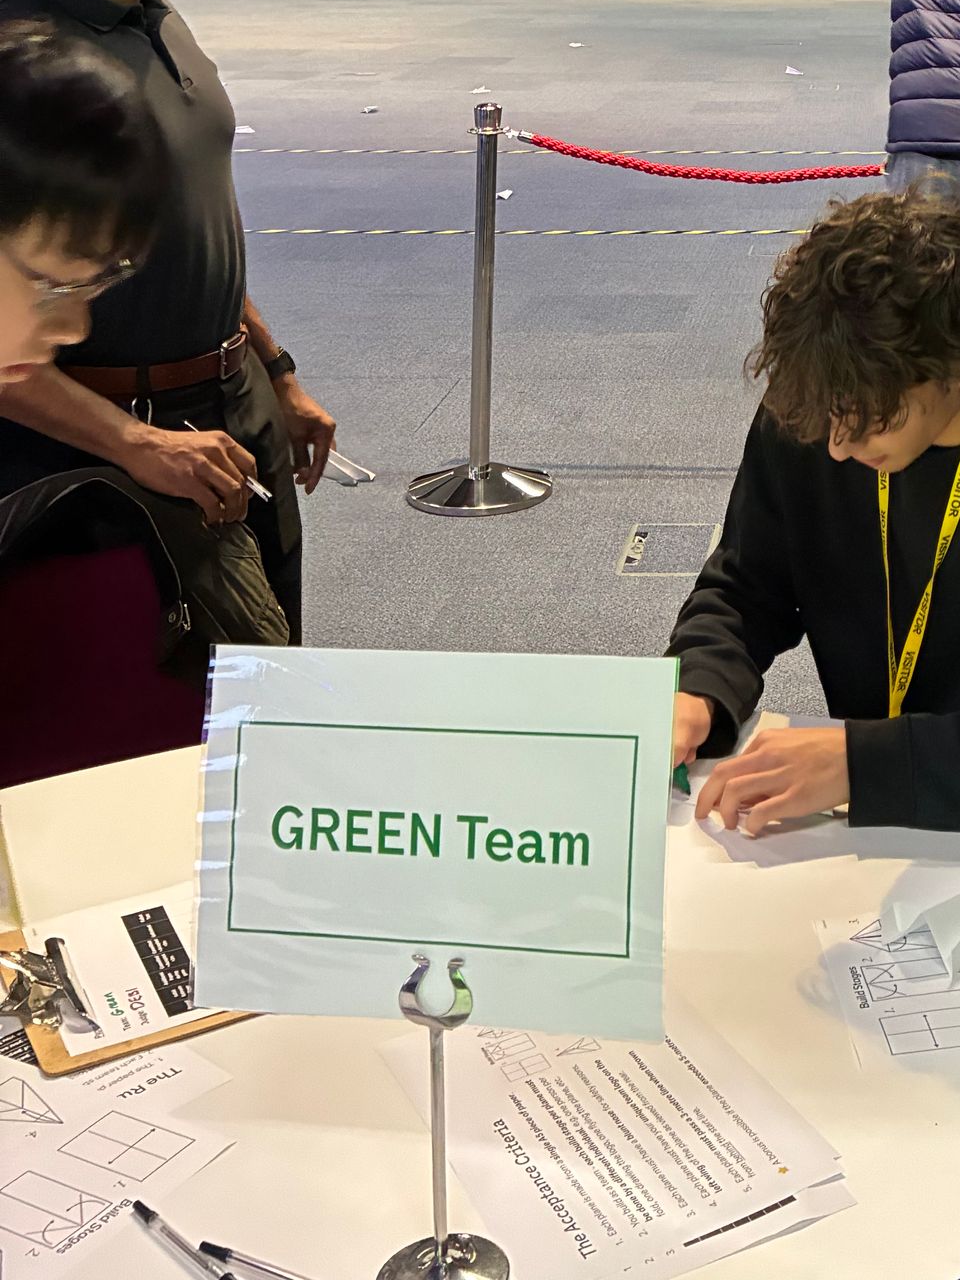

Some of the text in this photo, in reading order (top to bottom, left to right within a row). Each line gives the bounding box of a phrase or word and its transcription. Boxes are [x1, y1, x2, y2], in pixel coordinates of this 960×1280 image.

[913, 592, 930, 635] VISITOR
[898, 651, 916, 692] VISITOR
[272, 805, 589, 866] GREEN Team
[849, 966, 870, 1009] Build Stages
[628, 1050, 648, 1071] thrown
[109, 1070, 135, 1088] paper
[146, 1067, 183, 1085] The
[117, 1084, 147, 1099] Ru
[536, 1093, 554, 1111] plane
[665, 1093, 689, 1119] 3-metre
[629, 1102, 650, 1123] unique
[525, 1116, 543, 1134] piece
[555, 1119, 572, 1137] stage
[543, 1141, 561, 1161] single
[565, 1135, 583, 1153] build
[713, 1150, 734, 1168] plane
[679, 1164, 700, 1183] plane
[492, 1118, 598, 1260] The Acceptance Criteria
[587, 1201, 608, 1221] plane
[612, 1197, 632, 1216] build
[56, 1199, 133, 1254] Build Stages
